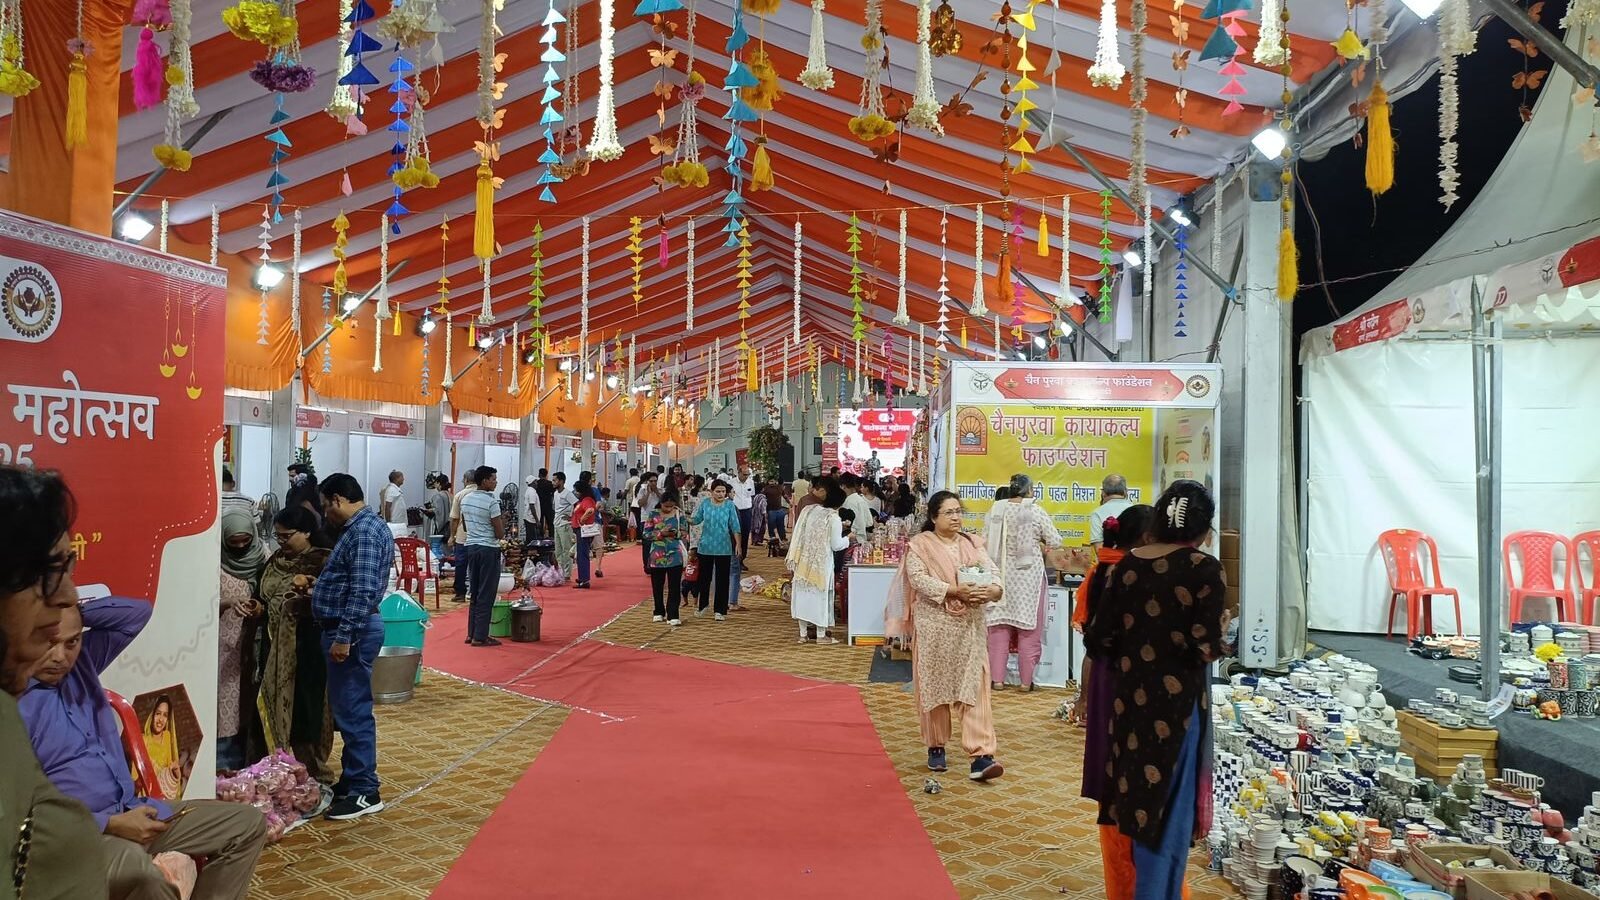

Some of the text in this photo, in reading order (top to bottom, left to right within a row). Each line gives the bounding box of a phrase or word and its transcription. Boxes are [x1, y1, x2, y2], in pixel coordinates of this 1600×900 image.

[1024, 372, 1041, 385] चैन
[1113, 372, 1153, 387] फाउंडेशन
[7, 370, 160, 444] महोत्सव
[990, 408, 1140, 442] चैनपुरवा कायाकल्प
[1022, 441, 1107, 469] फाउण्डेशन
[958, 481, 996, 500] सामाजिक
[1048, 486, 1067, 502] पहल
[1072, 482, 1095, 502] मिशन
